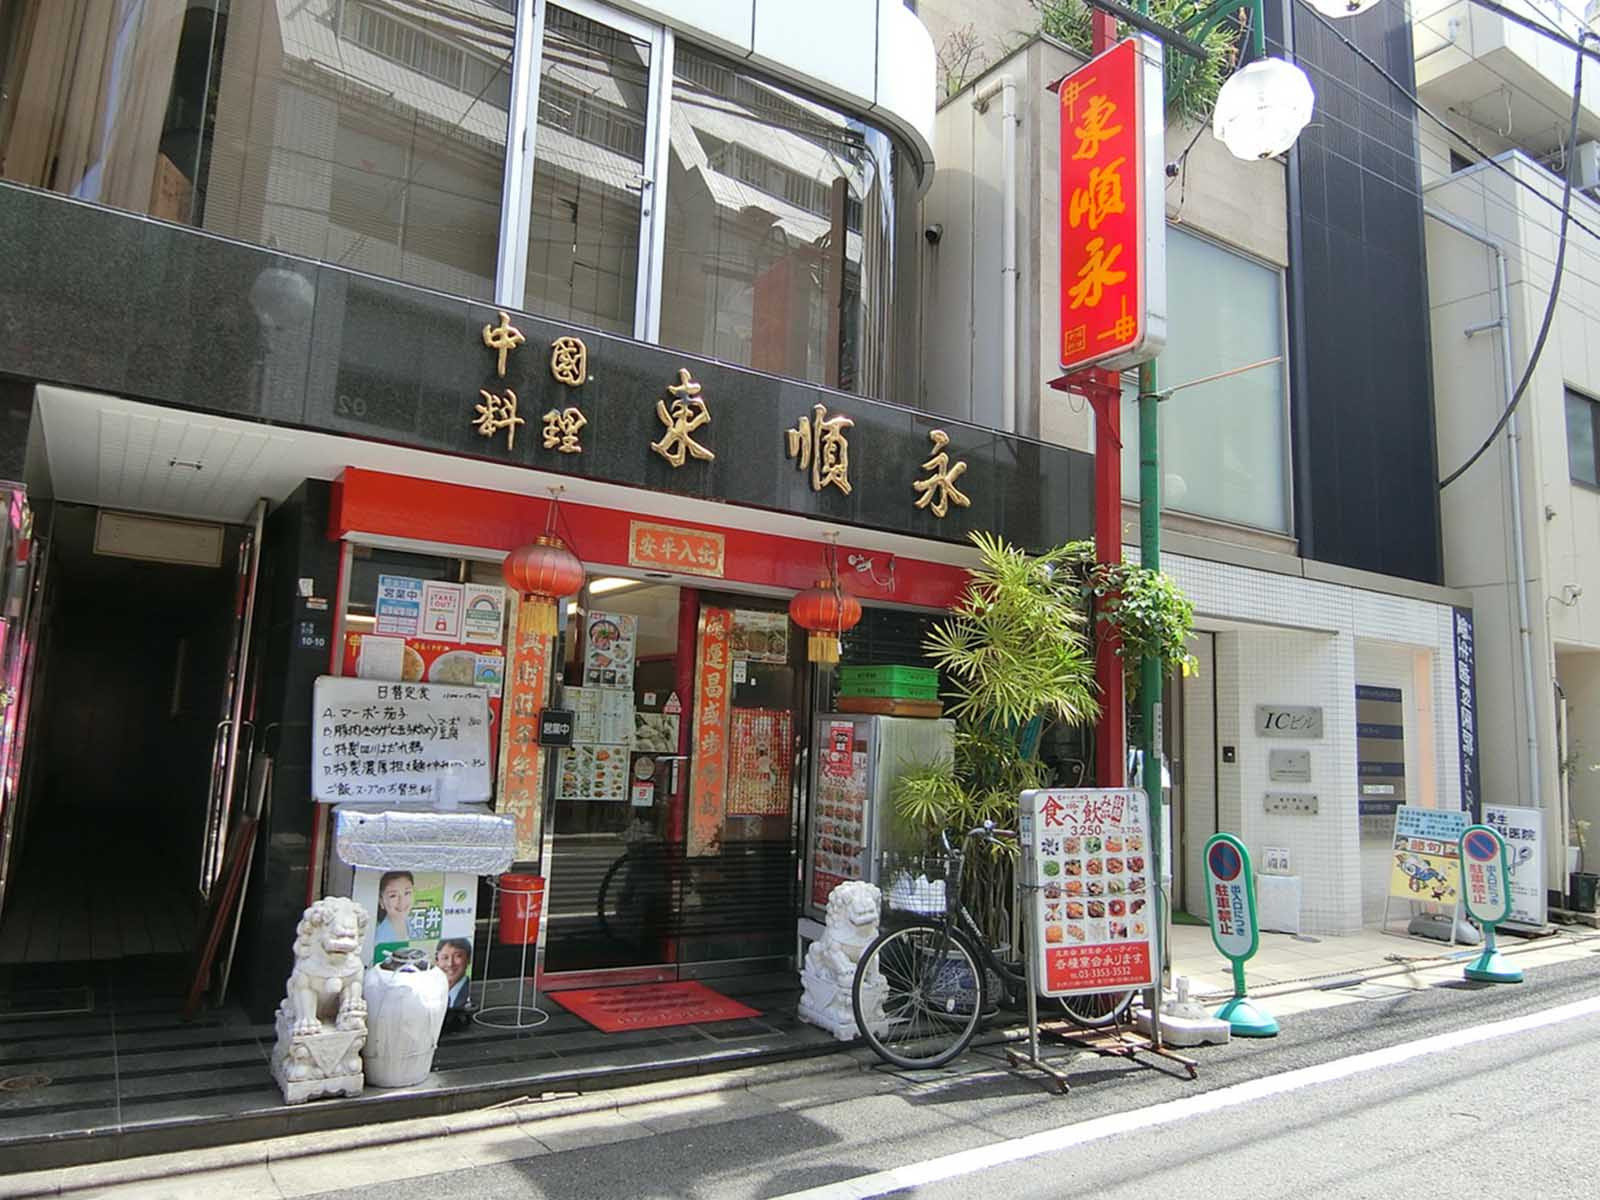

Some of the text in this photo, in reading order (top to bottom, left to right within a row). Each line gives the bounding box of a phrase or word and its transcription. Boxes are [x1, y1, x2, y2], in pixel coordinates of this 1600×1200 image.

[1068, 95, 1127, 310] 東順永
[472, 388, 588, 453] 料理
[650, 368, 973, 518] 東順永
[377, 684, 431, 701] 日替定食
[1215, 883, 1234, 936] 駐車禁止
[1230, 884, 1246, 937] 出入口につき
[1469, 863, 1487, 905] 駐車禁止
[410, 907, 441, 929] 石井
